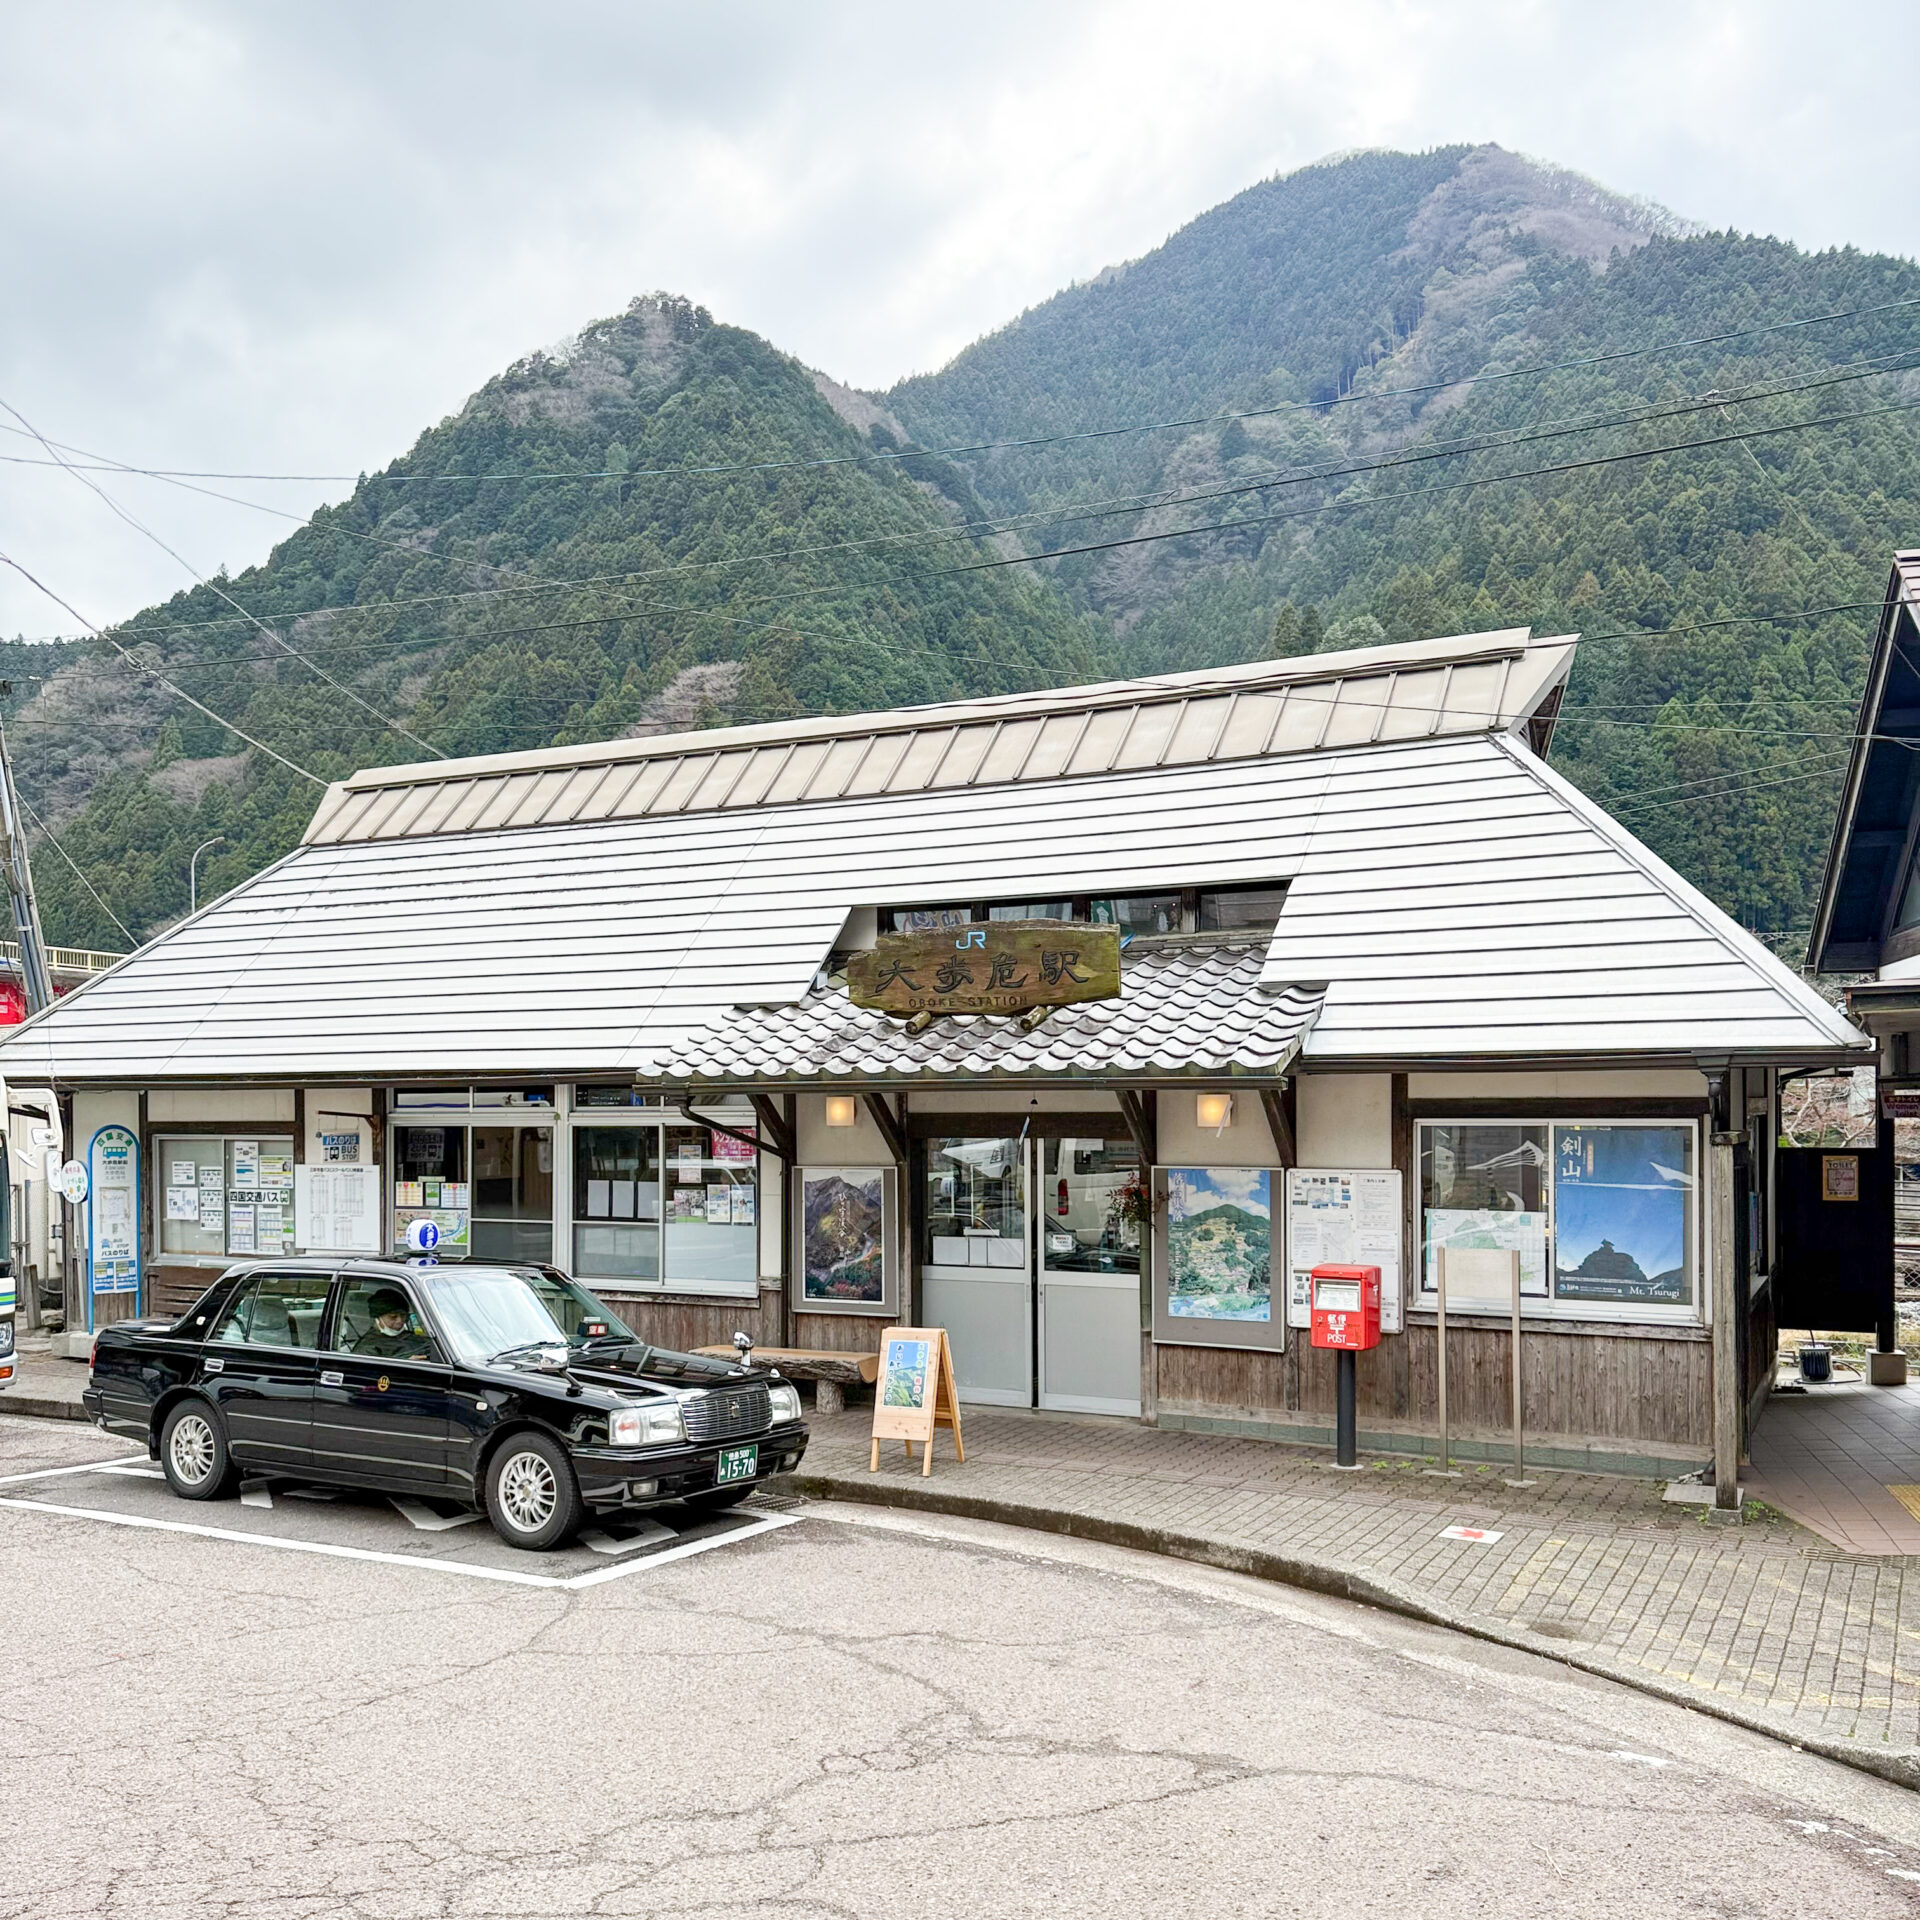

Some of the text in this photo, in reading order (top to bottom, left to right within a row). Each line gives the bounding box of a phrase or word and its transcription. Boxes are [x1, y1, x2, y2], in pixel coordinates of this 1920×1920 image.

[955, 931, 986, 950] JR
[875, 950, 1090, 994] 大歩危駅
[908, 995, 1028, 1009] OBOKE STATION
[326, 1135, 357, 1145] バスのりば
[341, 1145, 357, 1154] BUS
[1560, 1136, 1582, 1178] 剣山
[230, 1191, 278, 1202] 四国交通バス
[425, 1224, 434, 1248] 大歩危
[1629, 1286, 1645, 1296] Mt.
[1648, 1287, 1680, 1300] Tsurugi
[1327, 1314, 1346, 1326] 郵便
[1327, 1333, 1346, 1344] POST
[739, 1449, 750, 1459] 500
[727, 1458, 755, 1479] 15-70
